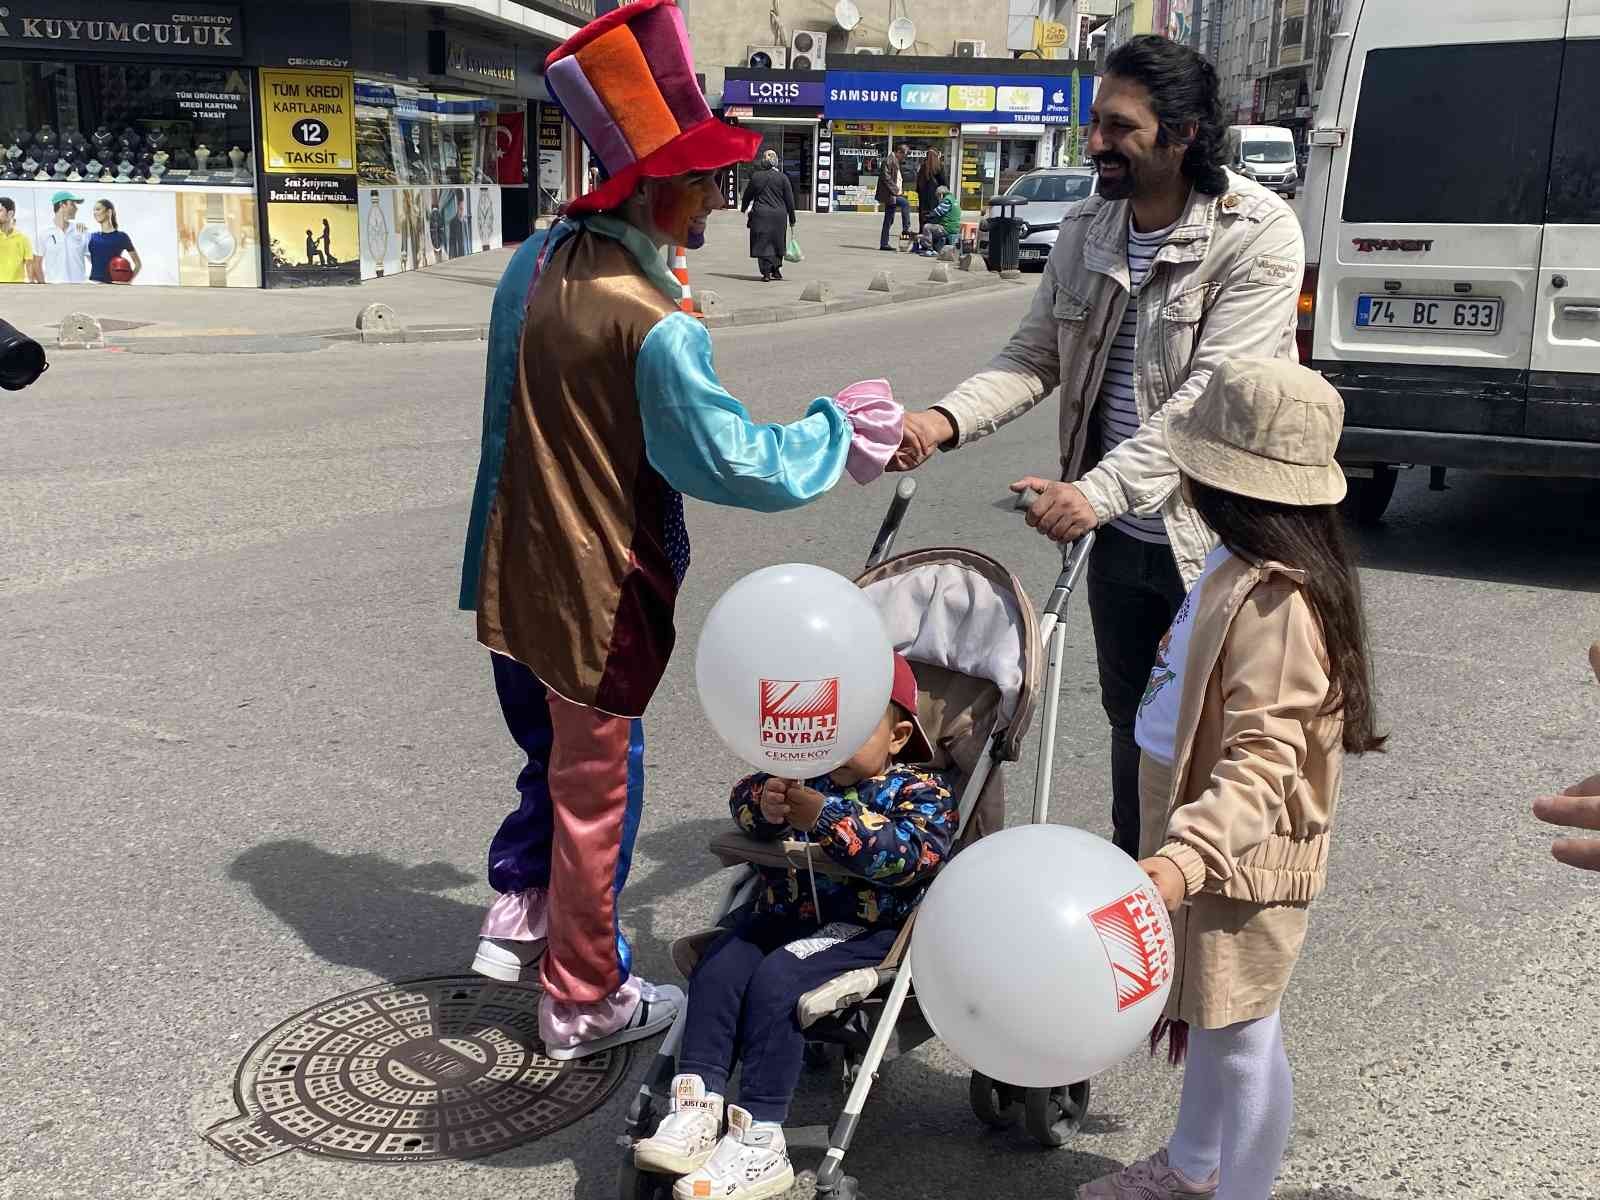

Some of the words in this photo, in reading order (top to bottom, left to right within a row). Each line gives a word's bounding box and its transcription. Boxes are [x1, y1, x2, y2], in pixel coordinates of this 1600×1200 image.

[21, 17, 233, 46] KUYUMCULUK
[272, 81, 299, 98] TÜM
[749, 82, 800, 97] LORIS
[830, 88, 898, 103] SAMSUNG
[272, 102, 344, 115] KARTLARINA
[1014, 114, 1040, 122] TELEFON
[300, 122, 322, 143] 12
[285, 150, 338, 165] TAKSİT
[1371, 301, 1395, 323] 74
[1412, 302, 1439, 325] BC
[1453, 303, 1493, 327] 633
[762, 729, 836, 743] POYRAZ
